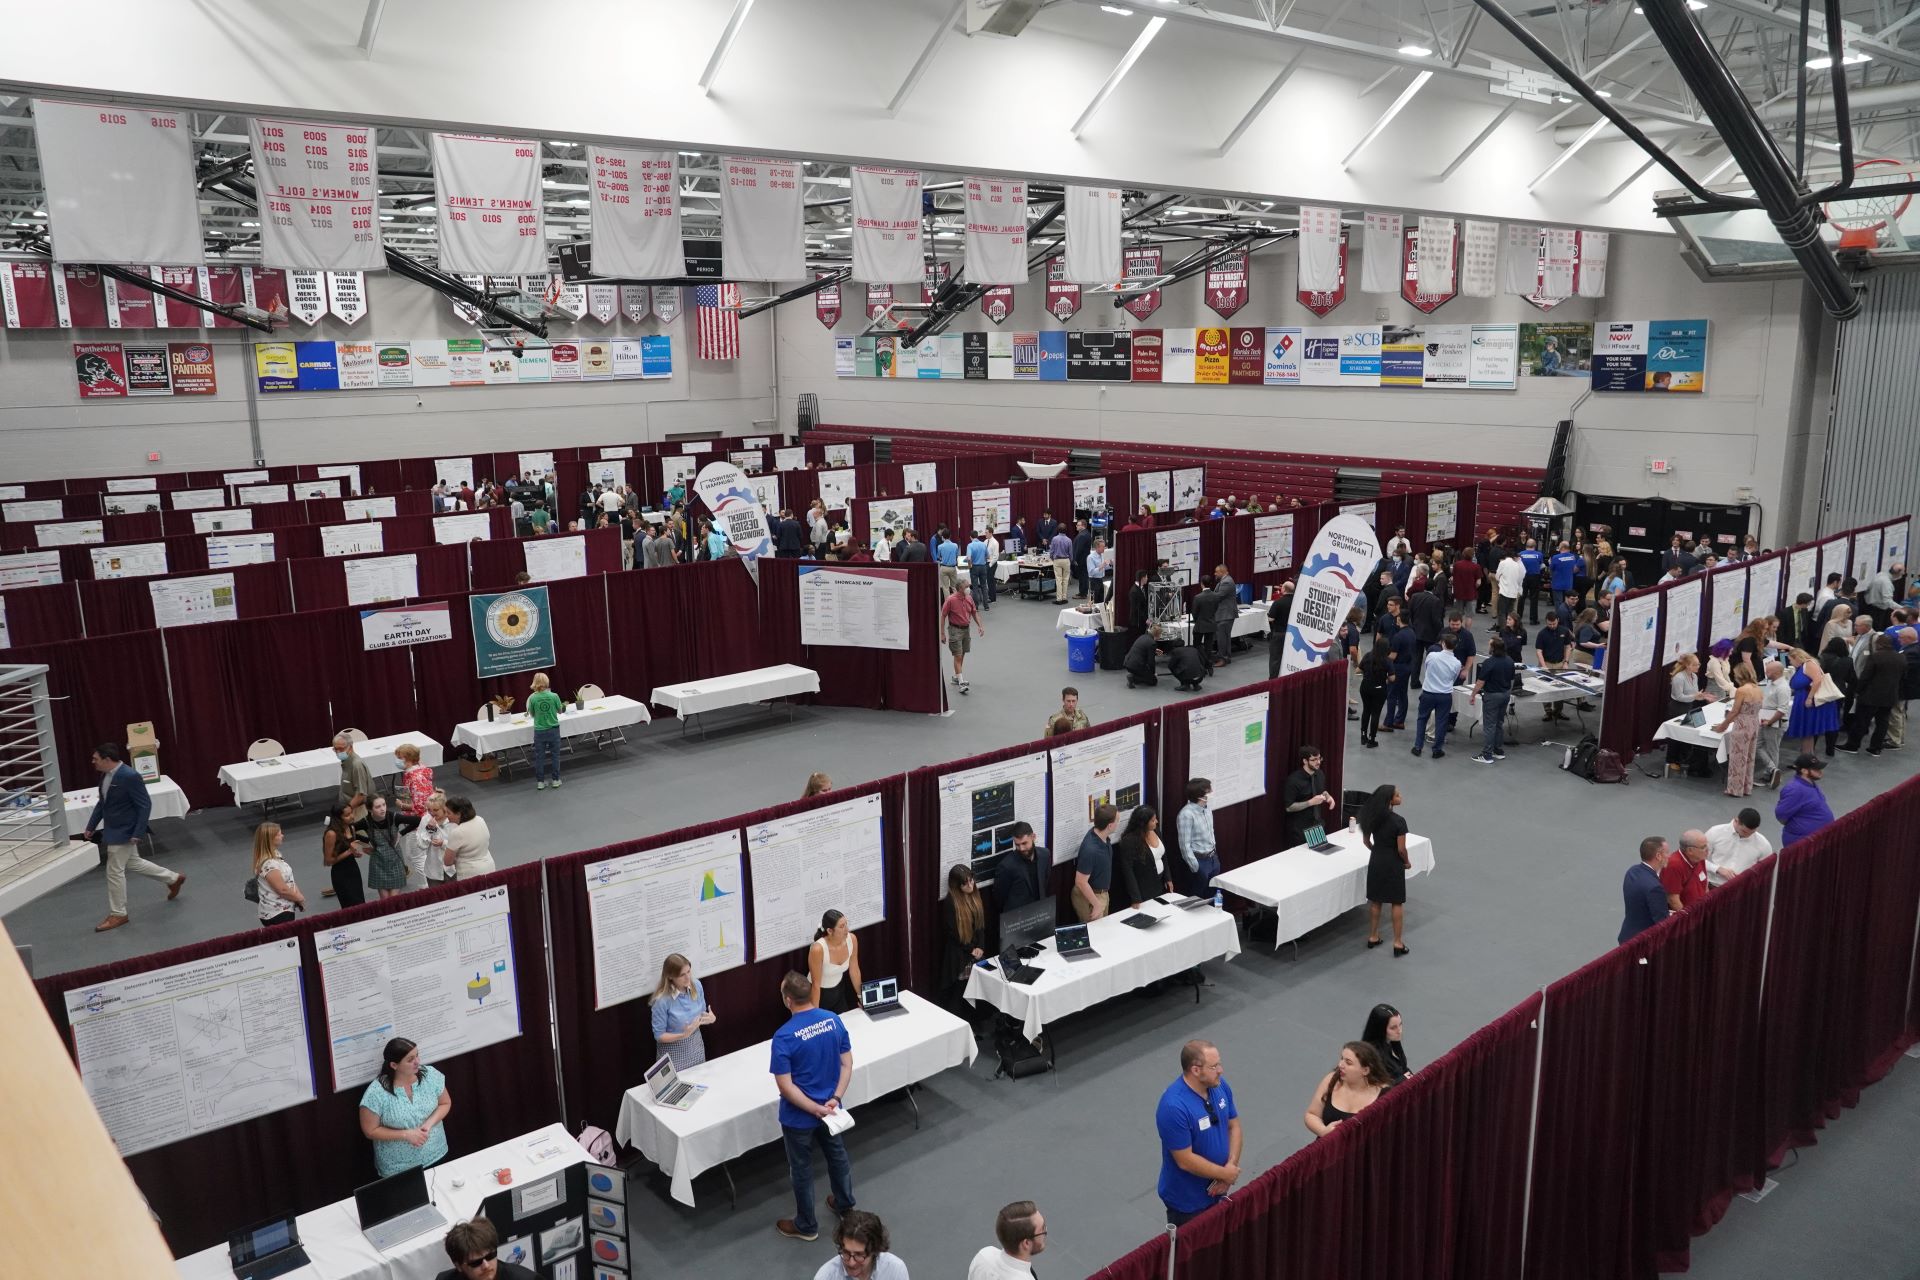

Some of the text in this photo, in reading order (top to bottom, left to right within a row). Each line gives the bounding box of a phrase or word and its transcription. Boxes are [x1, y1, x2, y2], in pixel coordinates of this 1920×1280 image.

[1130, 259, 1156, 267] NATIONAL
[1127, 268, 1156, 276] CHAMPION
[57, 285, 66, 306] SOCCER
[107, 285, 116, 306] SOCCER
[1354, 333, 1380, 346] SCB
[172, 352, 184, 364] GO
[1016, 346, 1037, 363] DAILY
[1048, 352, 1064, 360] pepsi
[173, 364, 212, 374] PANTHERS
[344, 359, 372, 367] Melbourne
[1654, 462, 1665, 470] EXIT
[1328, 531, 1363, 546] NORTHROP
[1332, 540, 1367, 556] GRUMMAN
[1308, 587, 1342, 606] STUDENT
[1303, 598, 1338, 622] DESIGN
[1296, 612, 1334, 635] SHOWCASE
[384, 630, 413, 640] EARTH
[398, 634, 447, 644] ORGANIZATIONS
[794, 1020, 827, 1038] NORTHROP
[802, 1024, 832, 1040] GRUMMAN
